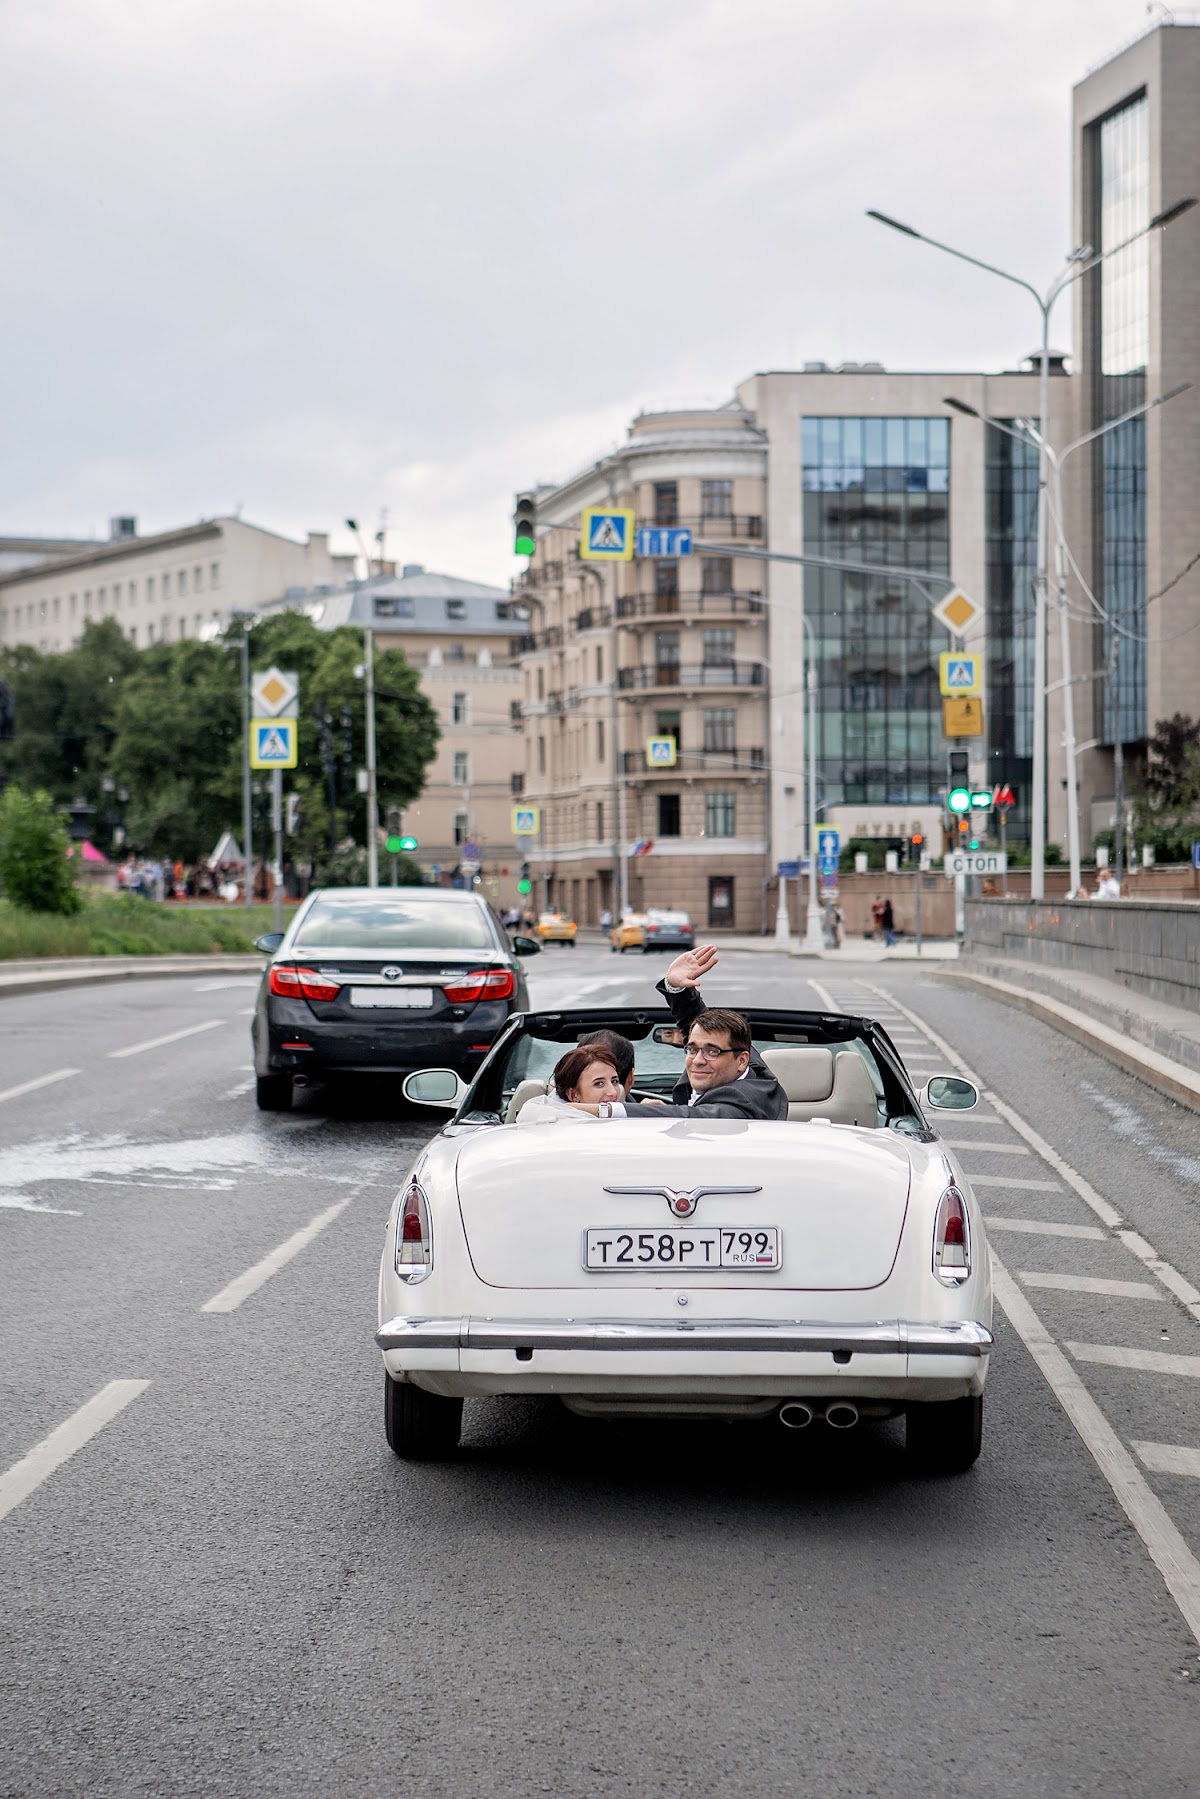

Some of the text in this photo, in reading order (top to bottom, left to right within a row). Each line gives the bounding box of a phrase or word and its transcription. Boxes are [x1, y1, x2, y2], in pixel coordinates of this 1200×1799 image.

[953, 858, 997, 871] СТОП
[722, 1232, 769, 1254] 799
[733, 1254, 755, 1262] RUS
